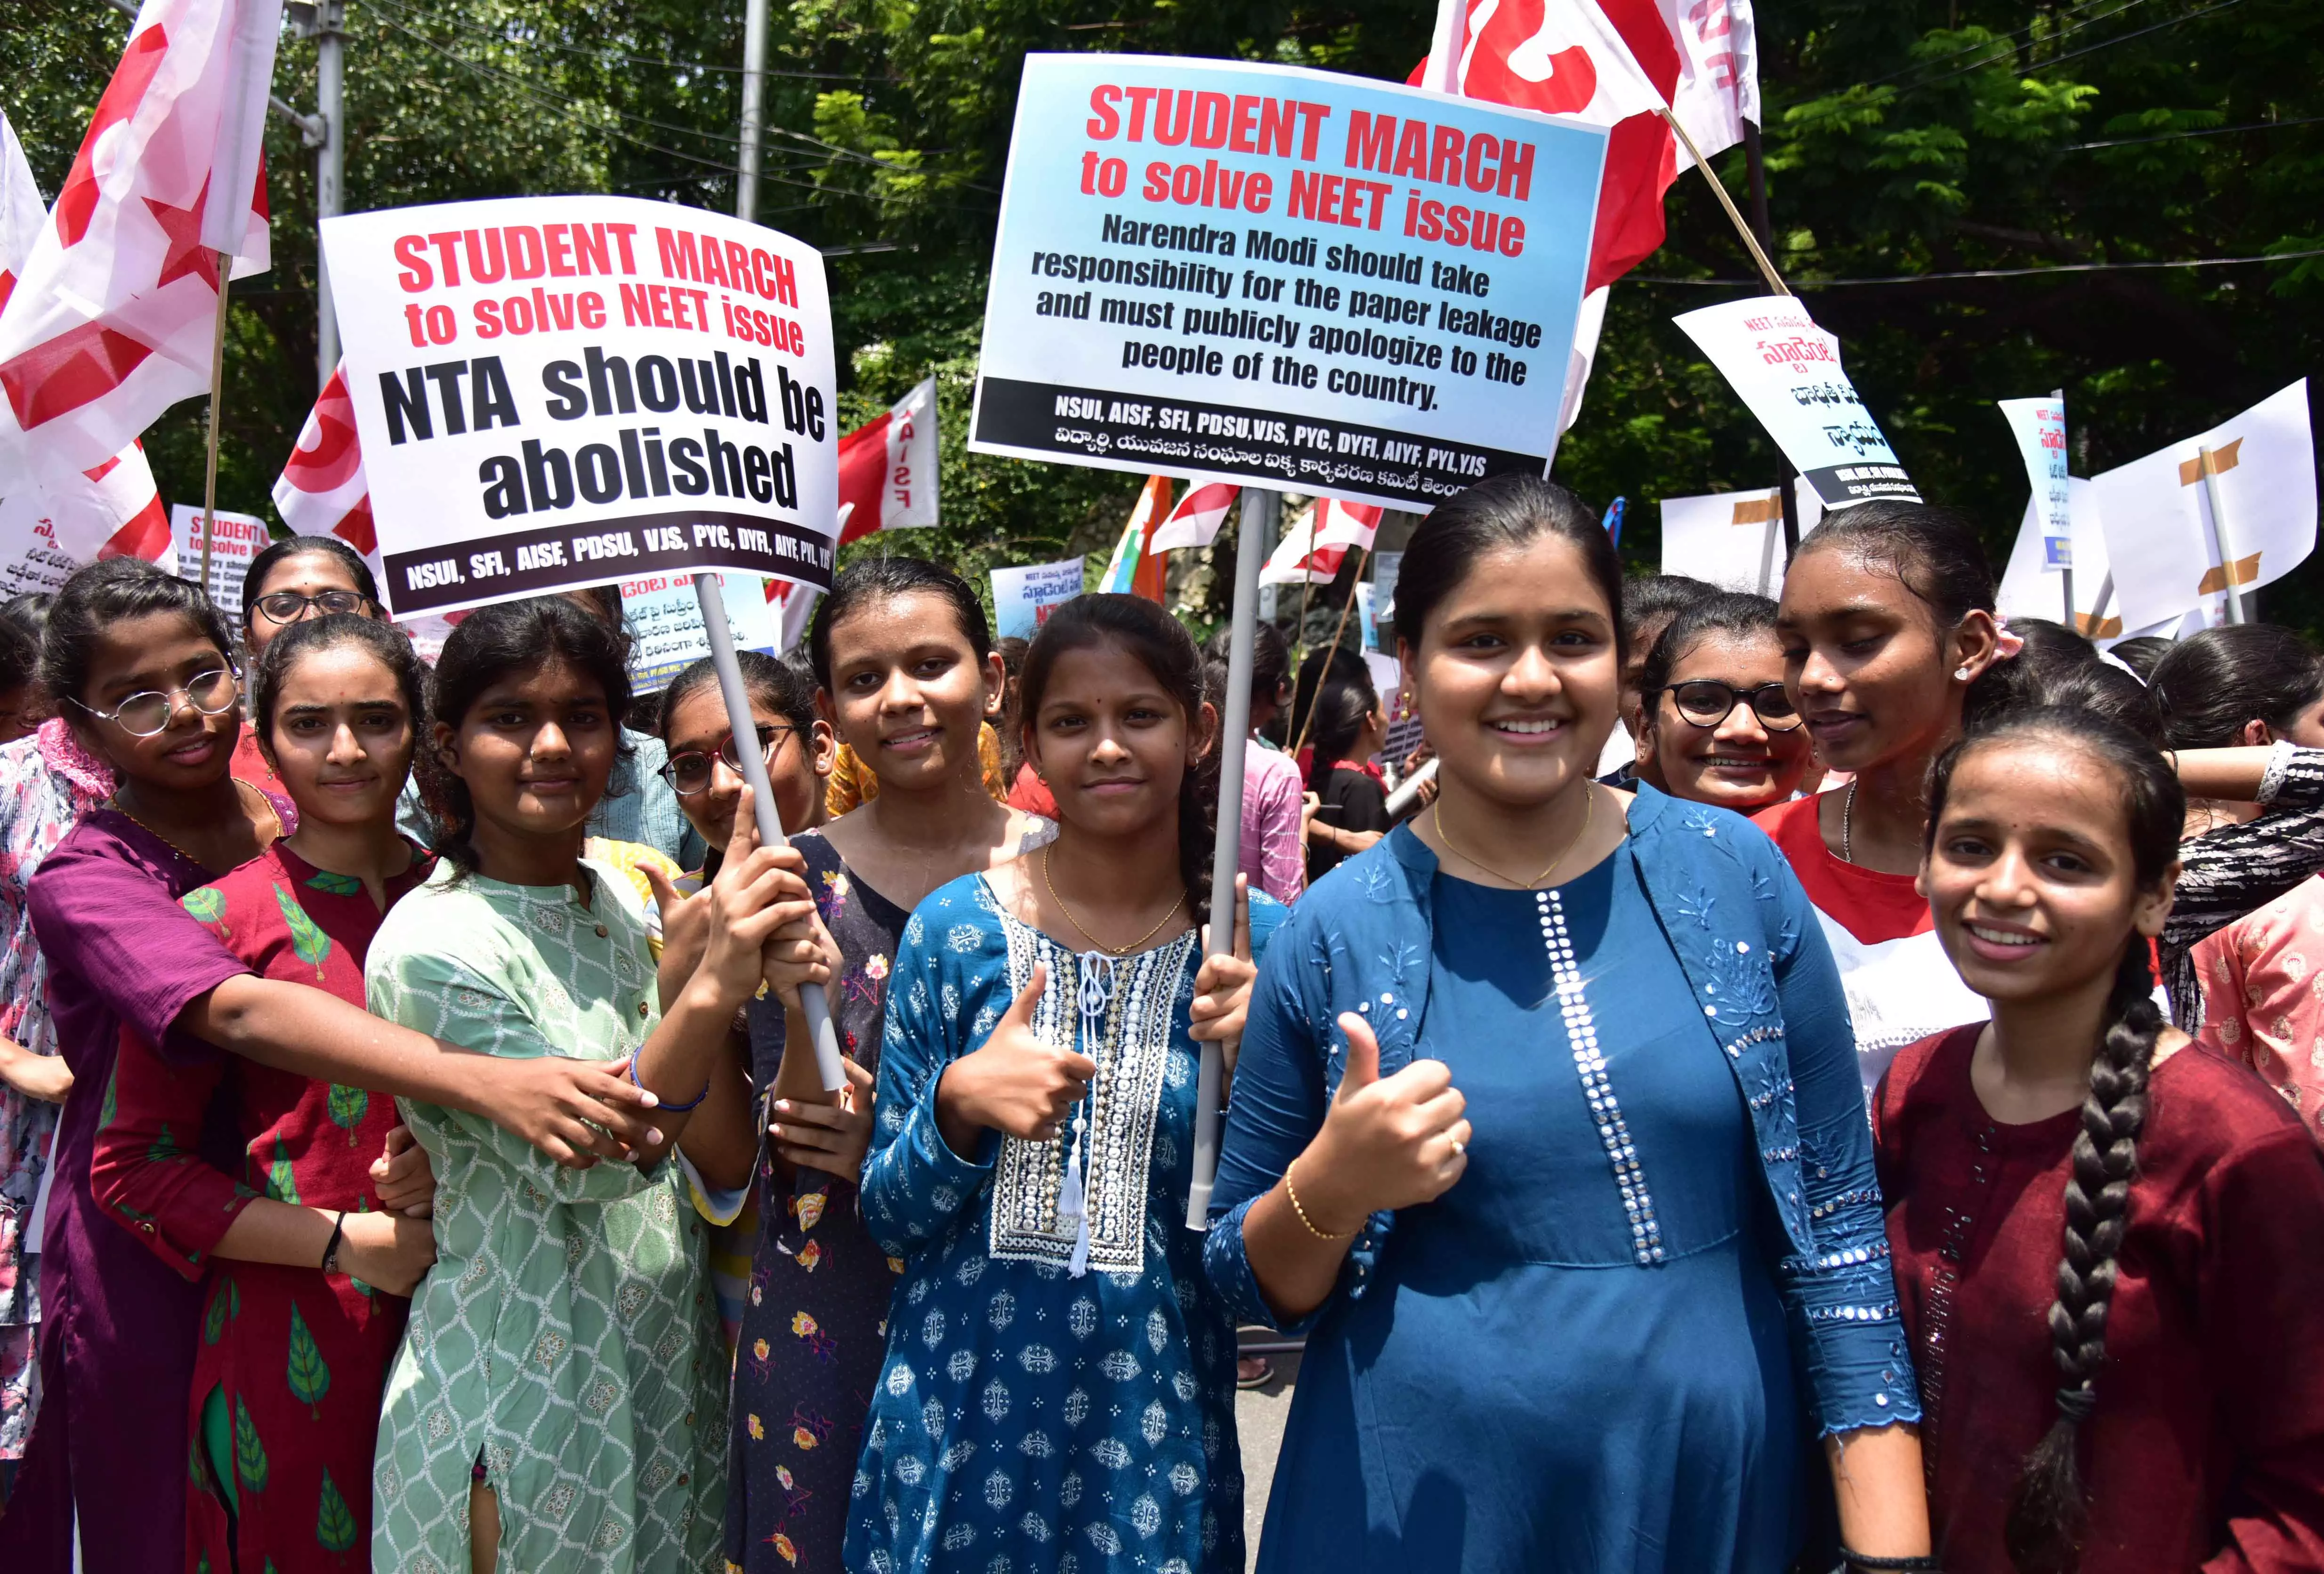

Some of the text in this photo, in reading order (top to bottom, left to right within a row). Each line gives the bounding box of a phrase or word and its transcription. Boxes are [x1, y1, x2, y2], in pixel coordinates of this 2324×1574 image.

[1087, 84, 1535, 201] STUDENT MARCH
[1081, 151, 1525, 257] to solve NEET issue
[394, 223, 799, 309] STUDENT MARCH
[1102, 214, 1490, 297] Narendra Modi should take
[404, 283, 805, 357] to solve NEET issue
[1032, 251, 1541, 348] responsibility for the paper leakage
[1036, 291, 1527, 386] and must publicly apologize to the
[379, 346, 825, 445] NTA should be
[1122, 341, 1438, 411] people of the country.
[479, 427, 798, 519] abolished
[1055, 395, 1105, 423] NSUI,
[1108, 402, 1154, 429] AISF,
[1159, 407, 1192, 434] SFI,
[1294, 425, 1332, 453] PYC,
[1337, 432, 1380, 460] DYFI,
[1383, 440, 1422, 468] AIYF,
[1116, 434, 1191, 457] యువజన
[191, 516, 258, 541] SUDENT
[211, 540, 247, 557] solve
[407, 525, 831, 591] NSUI, SFI, AISF, PDSU, VJS, PYC, DYFI, AIYF, PYL, YJS
